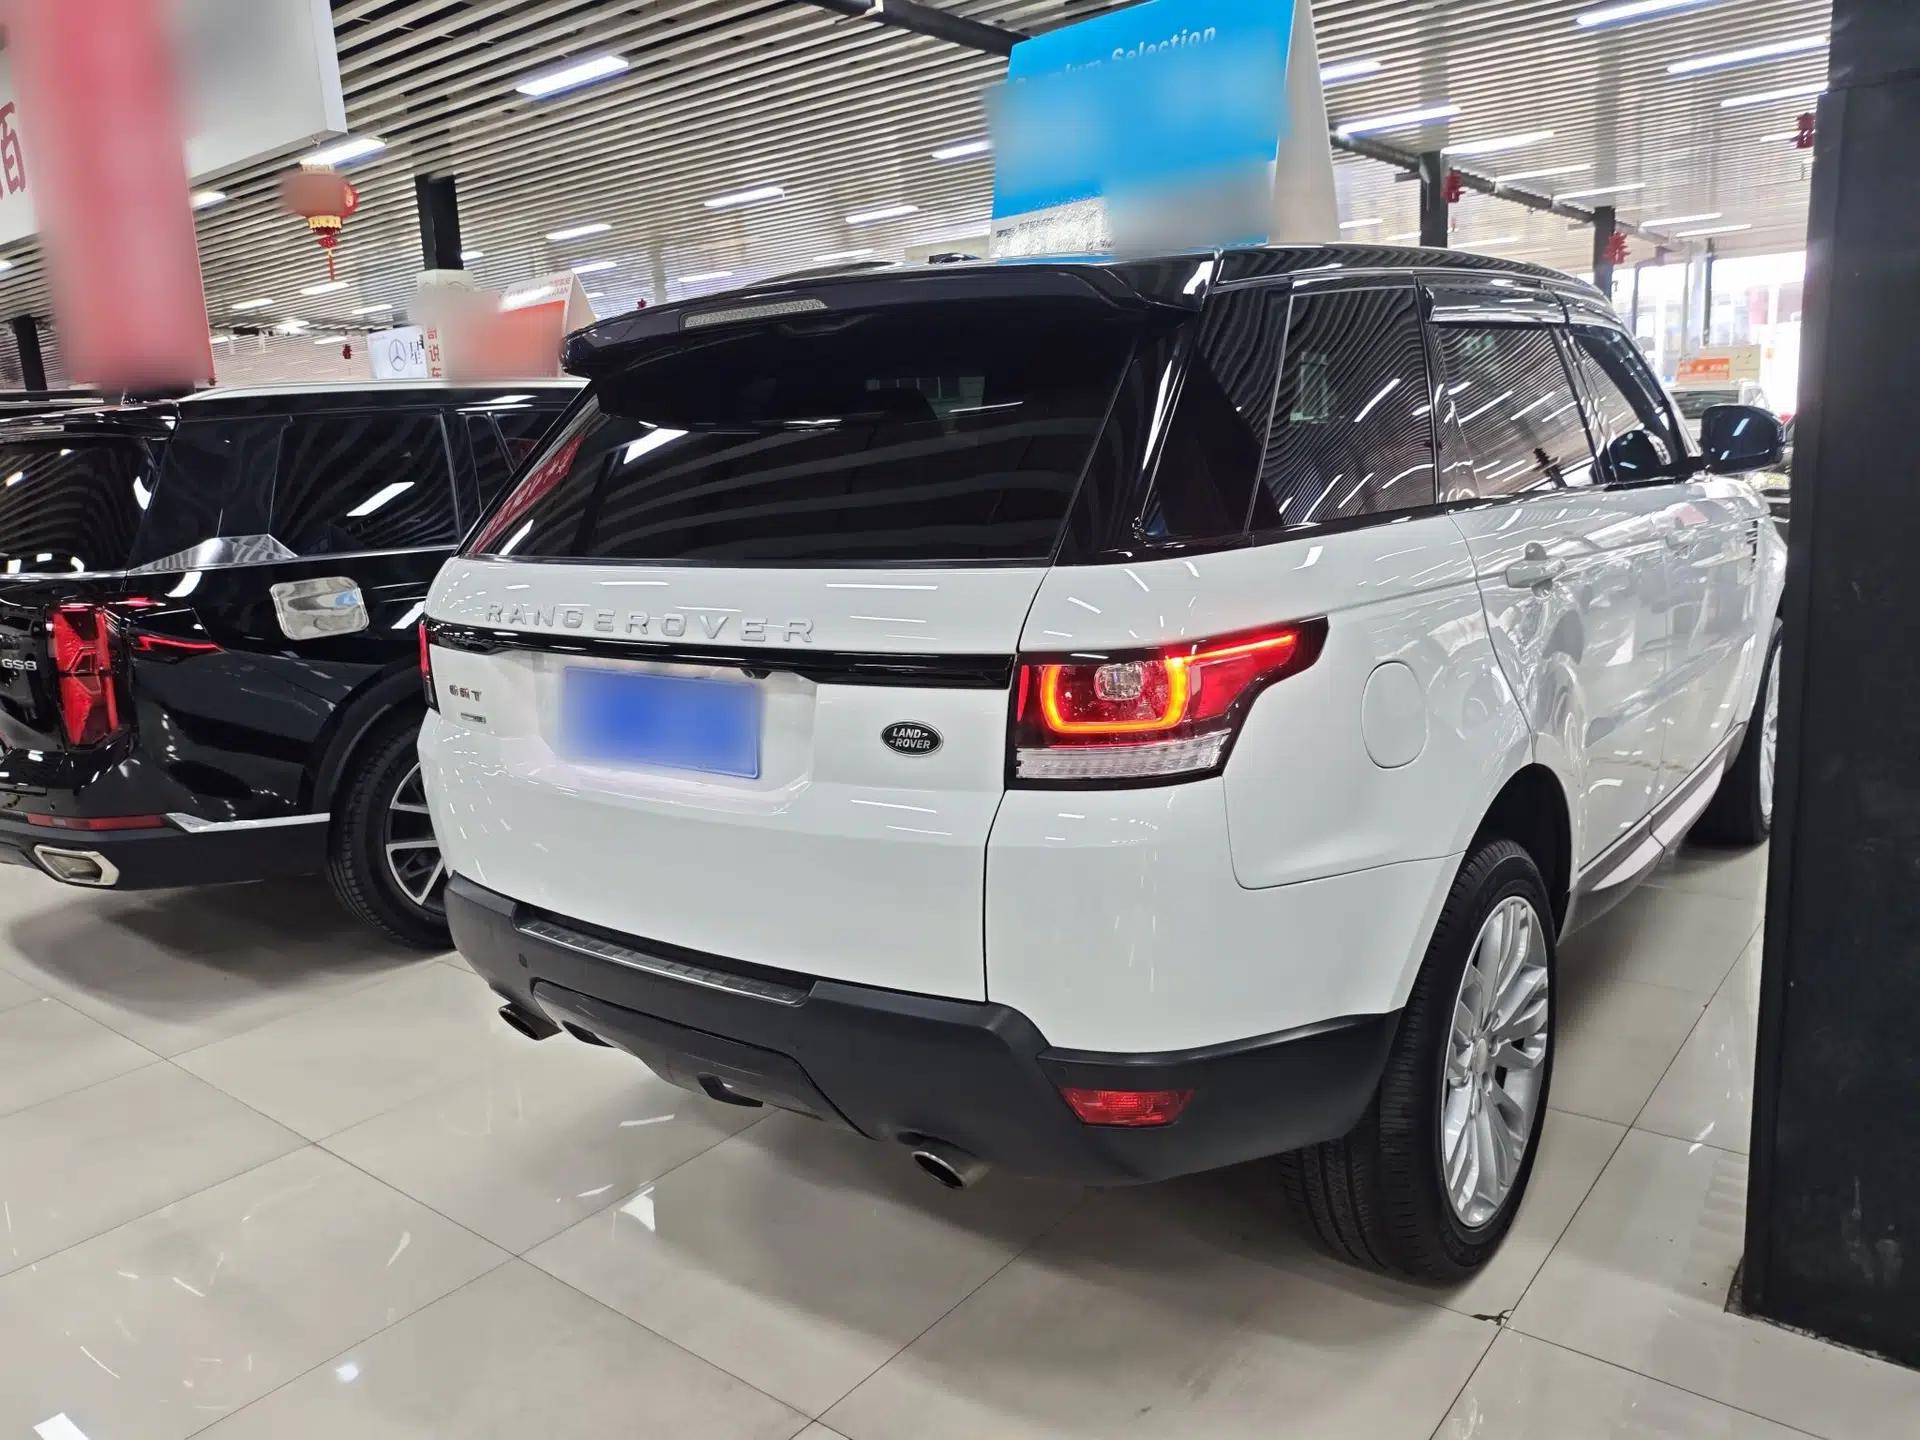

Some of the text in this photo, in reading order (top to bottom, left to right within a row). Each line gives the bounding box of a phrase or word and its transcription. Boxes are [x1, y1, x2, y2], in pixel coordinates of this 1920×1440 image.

[1, 658, 37, 671] GS8
[892, 727, 922, 739] LAND
[895, 738, 931, 749] ROVER
